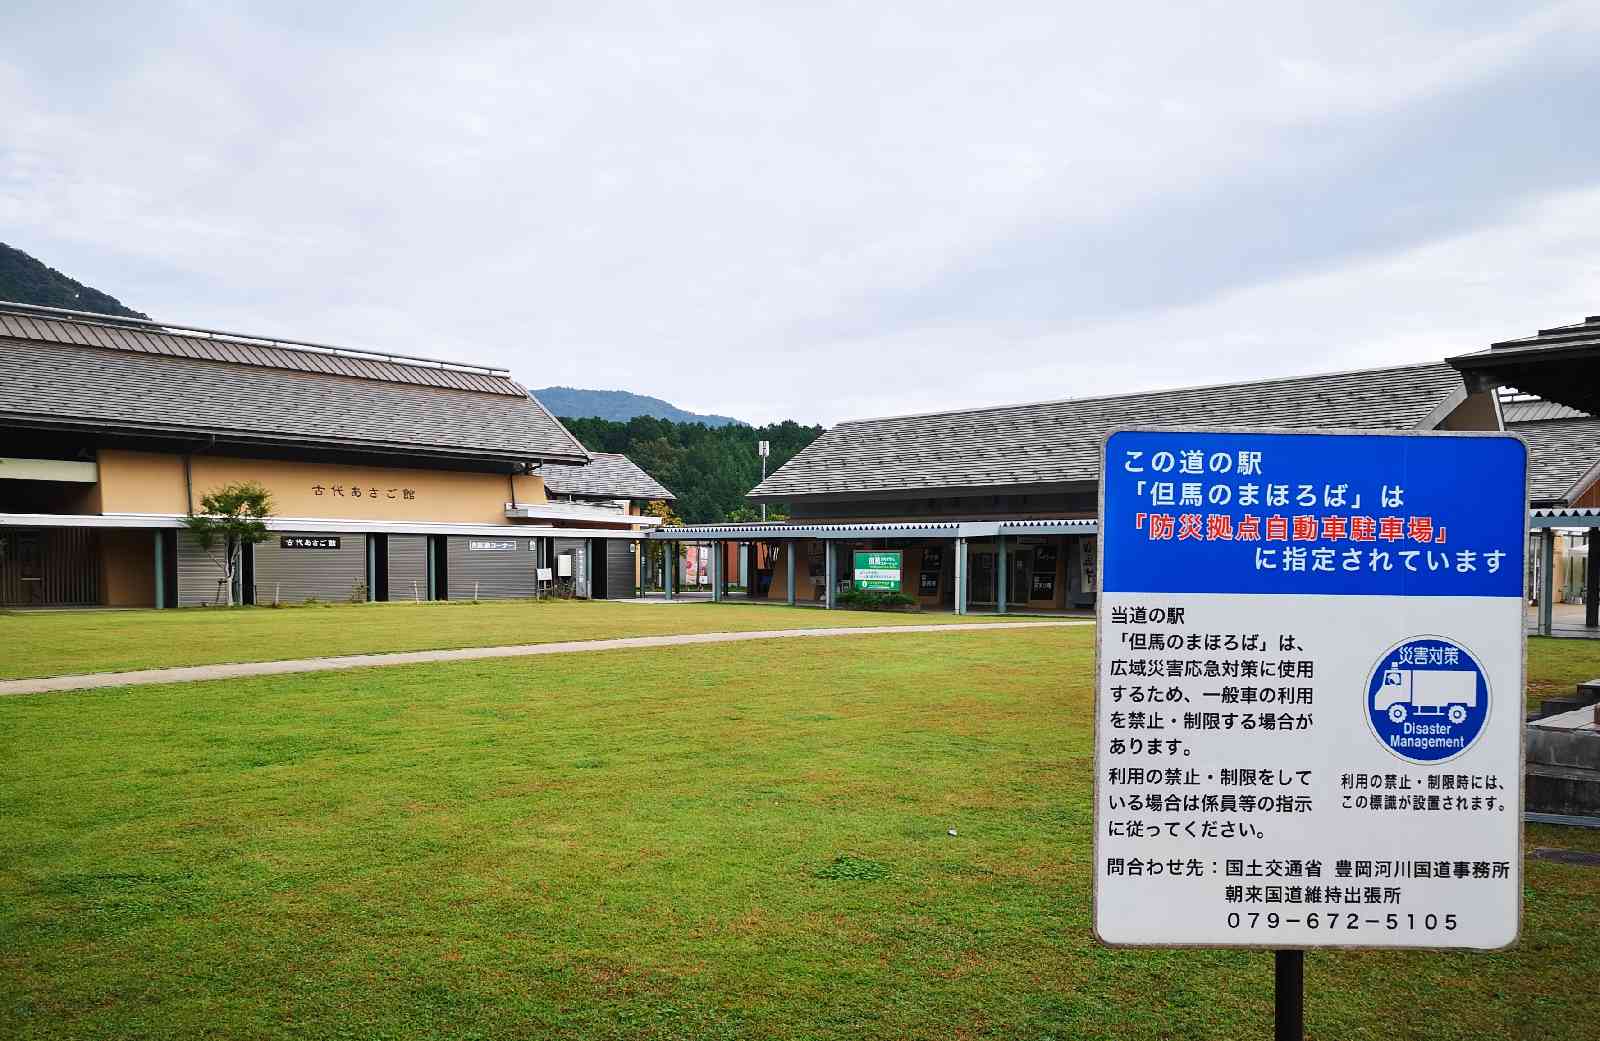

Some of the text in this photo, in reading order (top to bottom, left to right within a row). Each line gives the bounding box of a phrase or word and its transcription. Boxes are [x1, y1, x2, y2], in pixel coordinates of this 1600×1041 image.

[1124, 449, 1262, 476] この道の駅
[312, 485, 415, 500] 古代あさご館
[1255, 547, 1506, 574] に指定されています
[1111, 605, 1185, 625] 当道の駅
[1399, 646, 1459, 665] 災害対策
[1110, 659, 1314, 679] 広域災害応急対策に使用
[1110, 686, 1313, 705] するため、一般車の利用
[1110, 711, 1313, 731] を禁止・制限する場合が
[1403, 722, 1452, 735] Disaster
[1109, 737, 1191, 757] あります。
[1390, 735, 1465, 750] Management
[1108, 767, 1312, 787] 利用の禁止・制限をして
[1340, 773, 1505, 790] 利用の禁止・制限時には、
[1109, 793, 1313, 813] いる場合は係員等の指示
[1341, 795, 1505, 812] この標識が設置されます。
[1108, 820, 1265, 839] に従ってください。
[1335, 859, 1510, 879] 豊岡河川国道事務所
[1225, 885, 1401, 905] 朝来国道維持出張所
